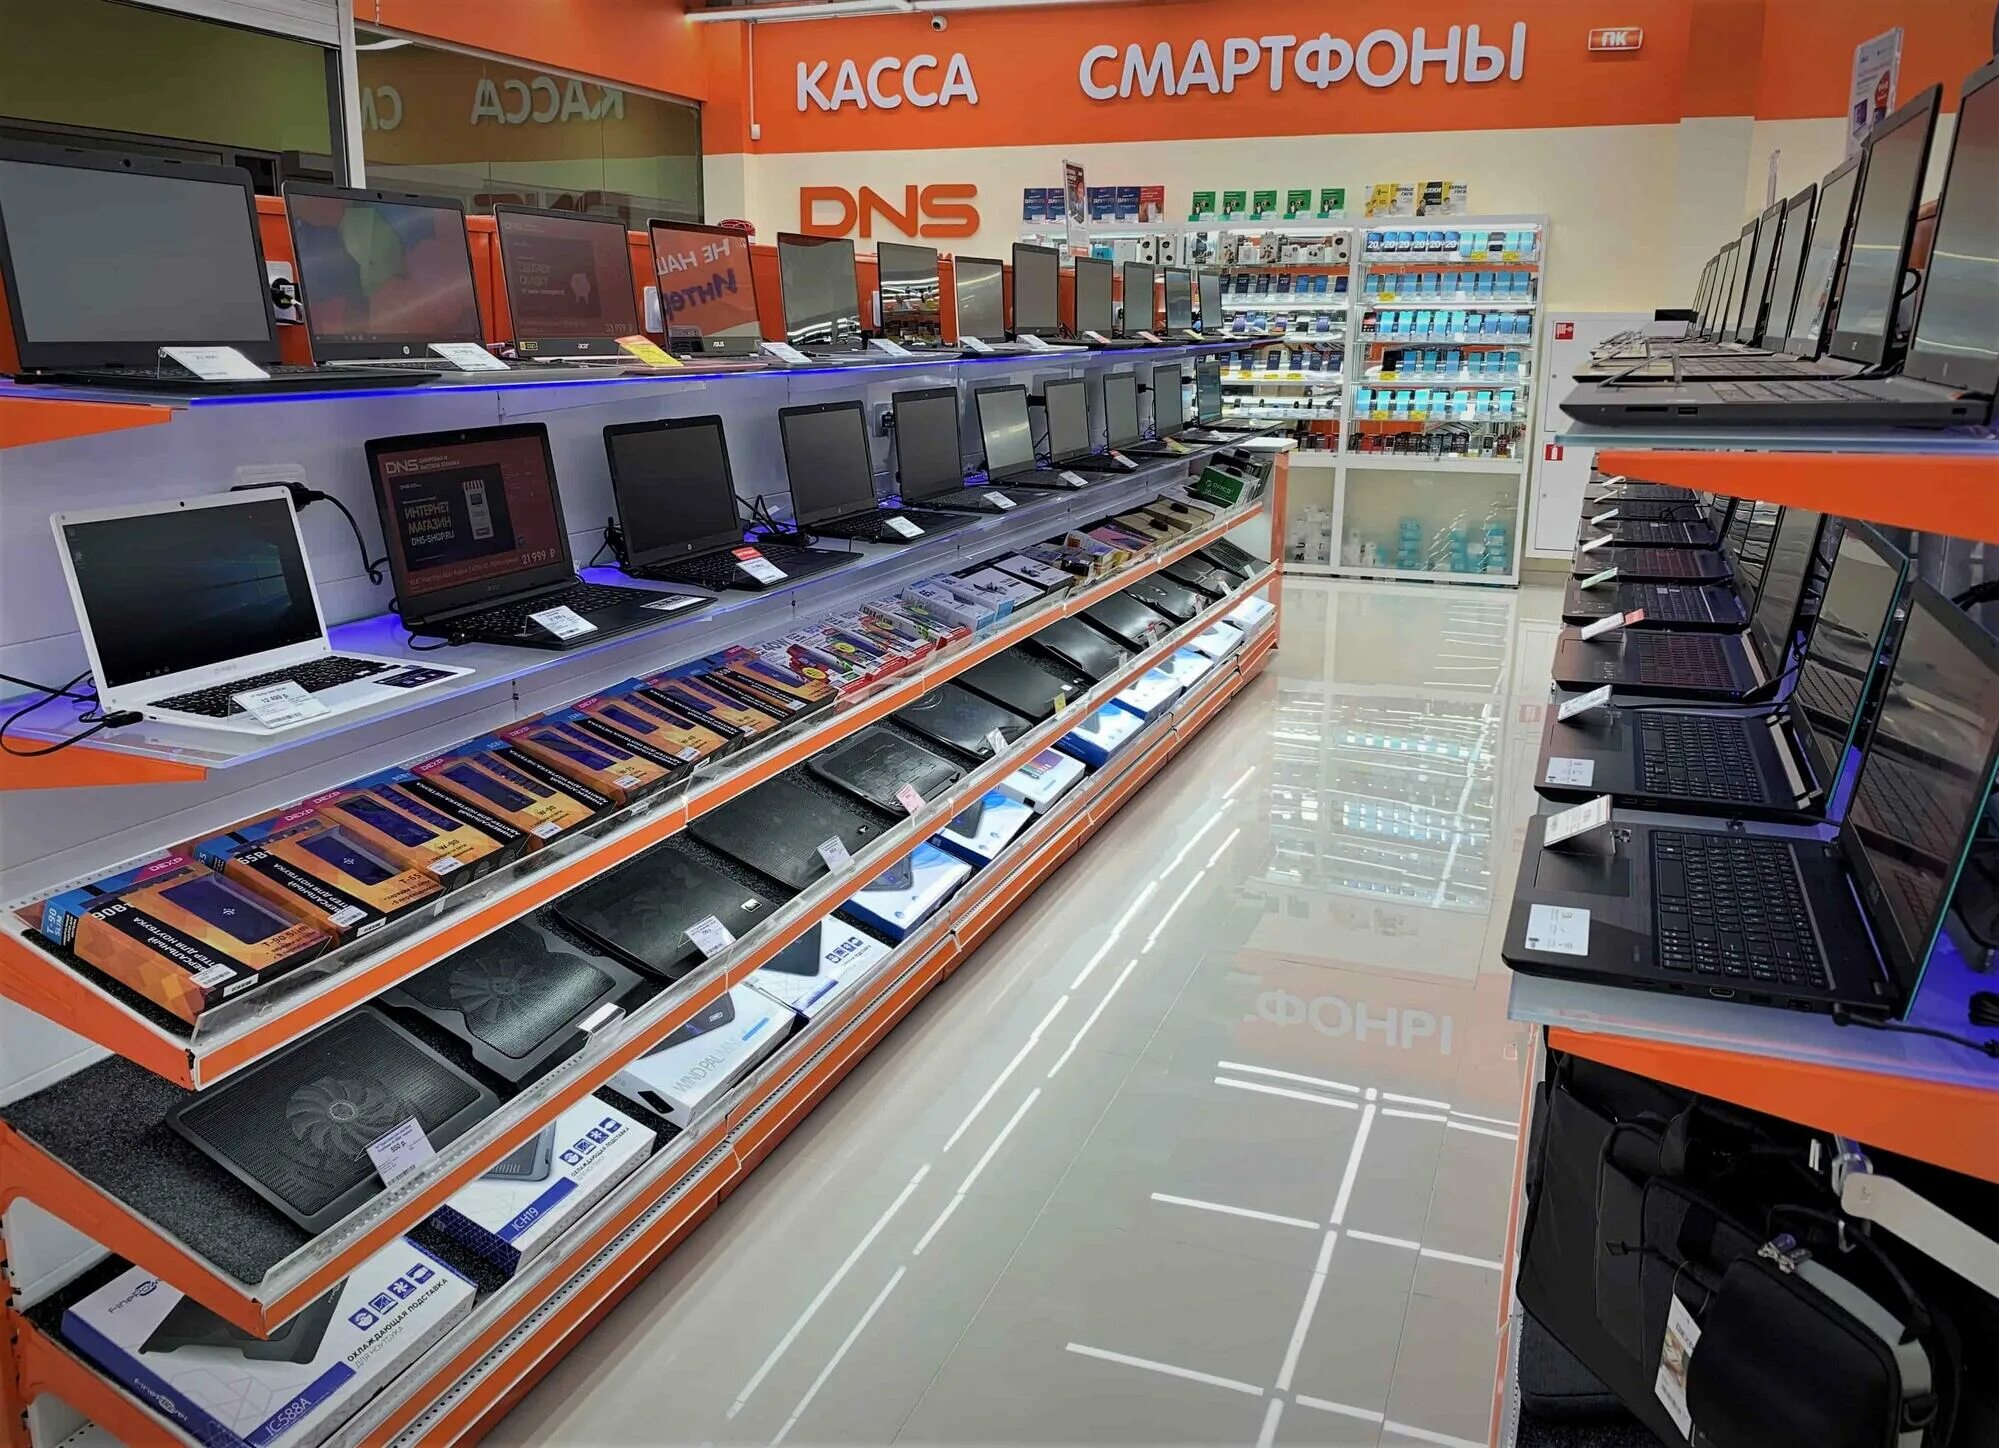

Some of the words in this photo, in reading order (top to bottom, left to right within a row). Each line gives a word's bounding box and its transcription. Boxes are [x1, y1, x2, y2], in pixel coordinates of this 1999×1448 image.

[1601, 31, 1628, 47] ПК
[1080, 22, 1526, 100] СМАРТФОНЫ
[797, 53, 978, 111] КАССА
[800, 184, 980, 238] DNS
[385, 458, 419, 475] DNS
[404, 501, 449, 519] ИНТЕРНЕТ
[408, 516, 452, 534] МАГАЗИН
[312, 791, 343, 804] DEXP
[285, 807, 315, 821] DEXP
[148, 857, 184, 872] DEXP
[46, 907, 58, 935] T-90
[54, 914, 63, 937] SLIM
[262, 934, 285, 949] T-90
[286, 925, 309, 940] Slim
[673, 1054, 726, 1093] WINDPAL
[511, 1207, 539, 1232] IC-H19
[347, 1311, 409, 1362] ОХЛАЖДАЮЩАЯ
[407, 1278, 449, 1311] ПОДСТАВКА
[354, 1353, 371, 1369] ДЛЯ
[265, 1397, 312, 1437] IC-588A
